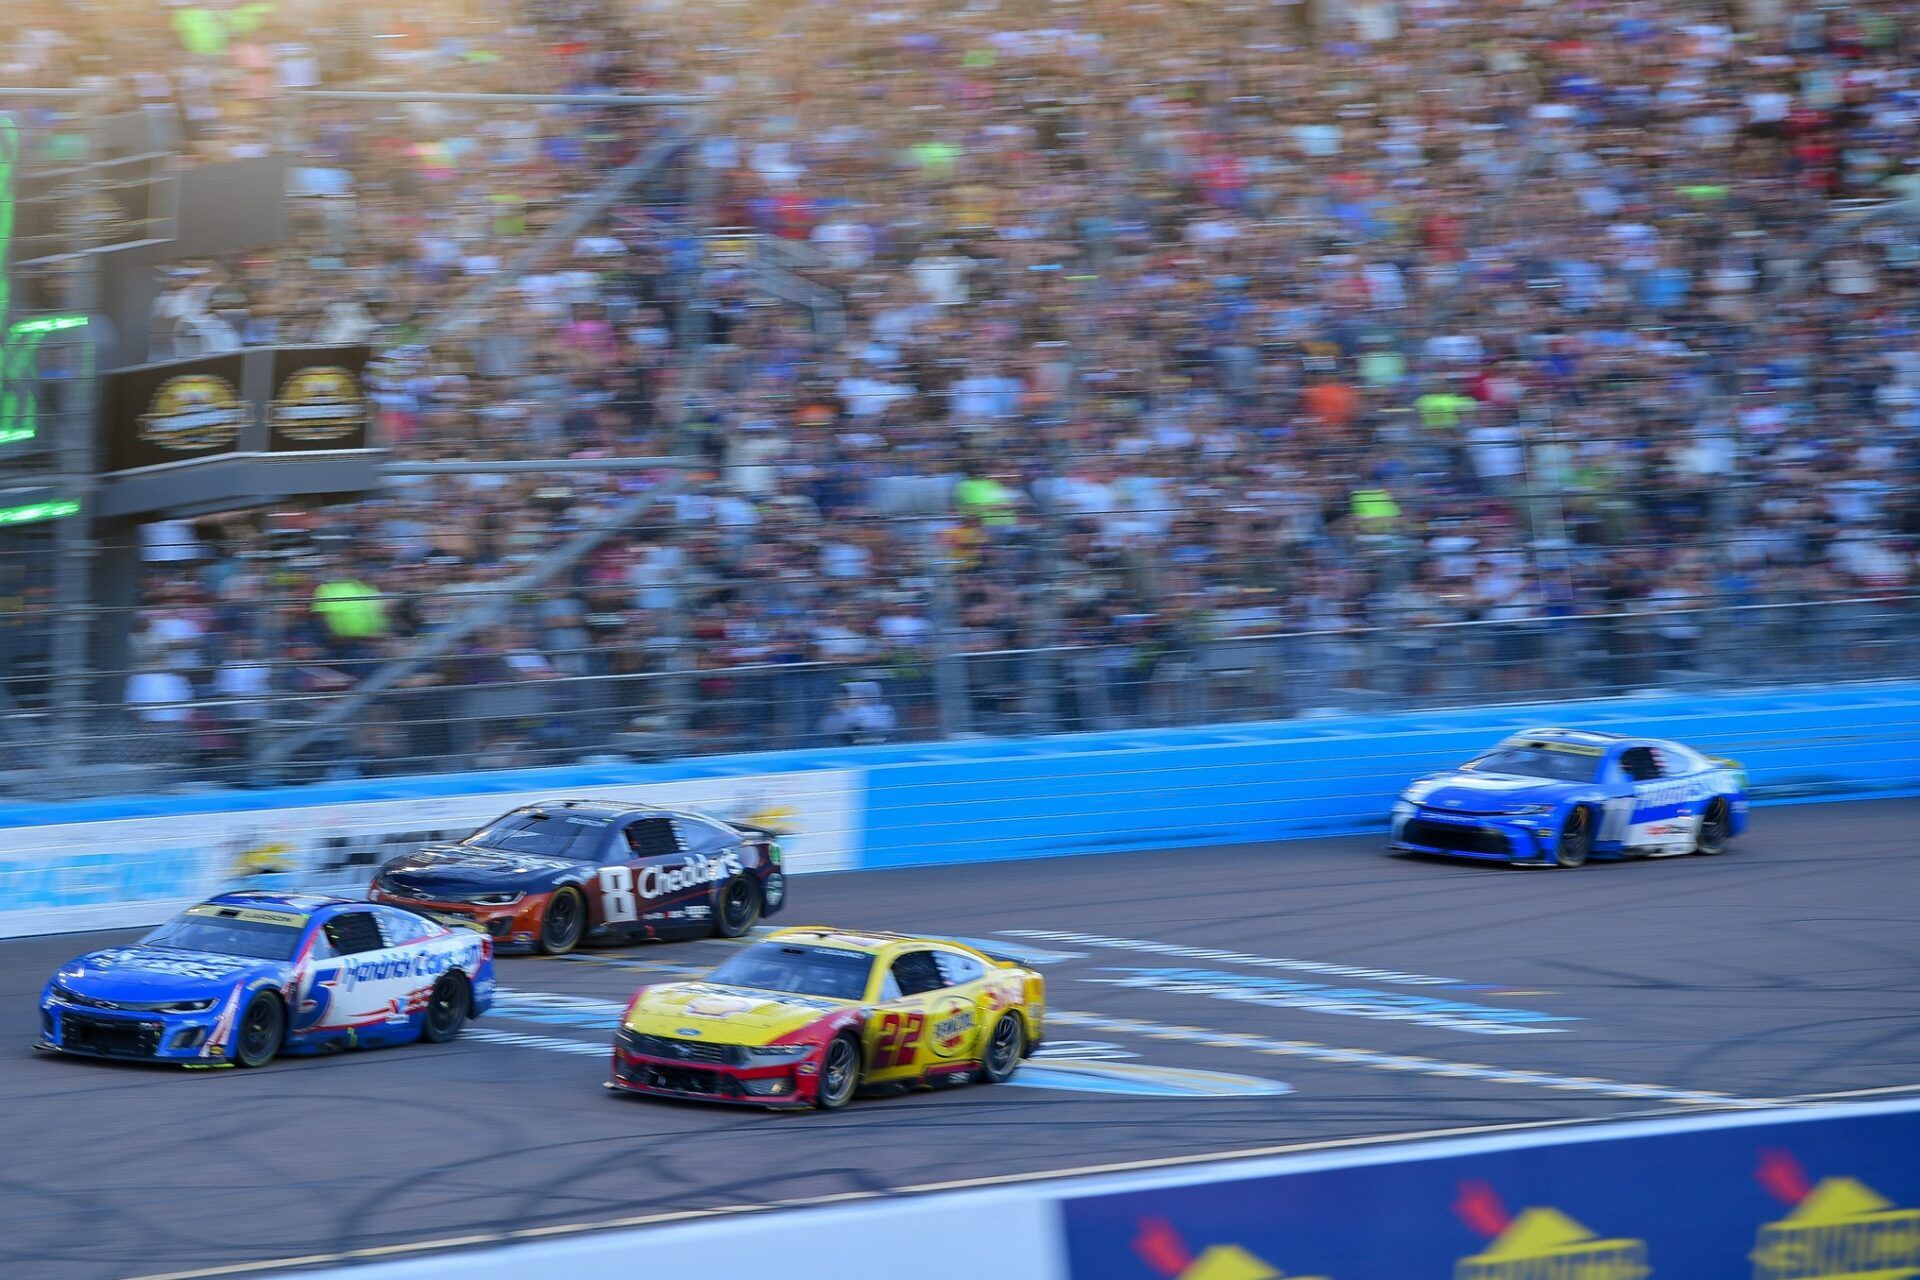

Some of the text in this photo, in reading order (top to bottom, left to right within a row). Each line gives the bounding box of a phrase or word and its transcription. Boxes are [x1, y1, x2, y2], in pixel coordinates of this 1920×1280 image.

[597, 865, 638, 923] 8
[637, 848, 744, 899] Cheddar's
[298, 968, 340, 1033] 5
[873, 1013, 925, 1069] 22
